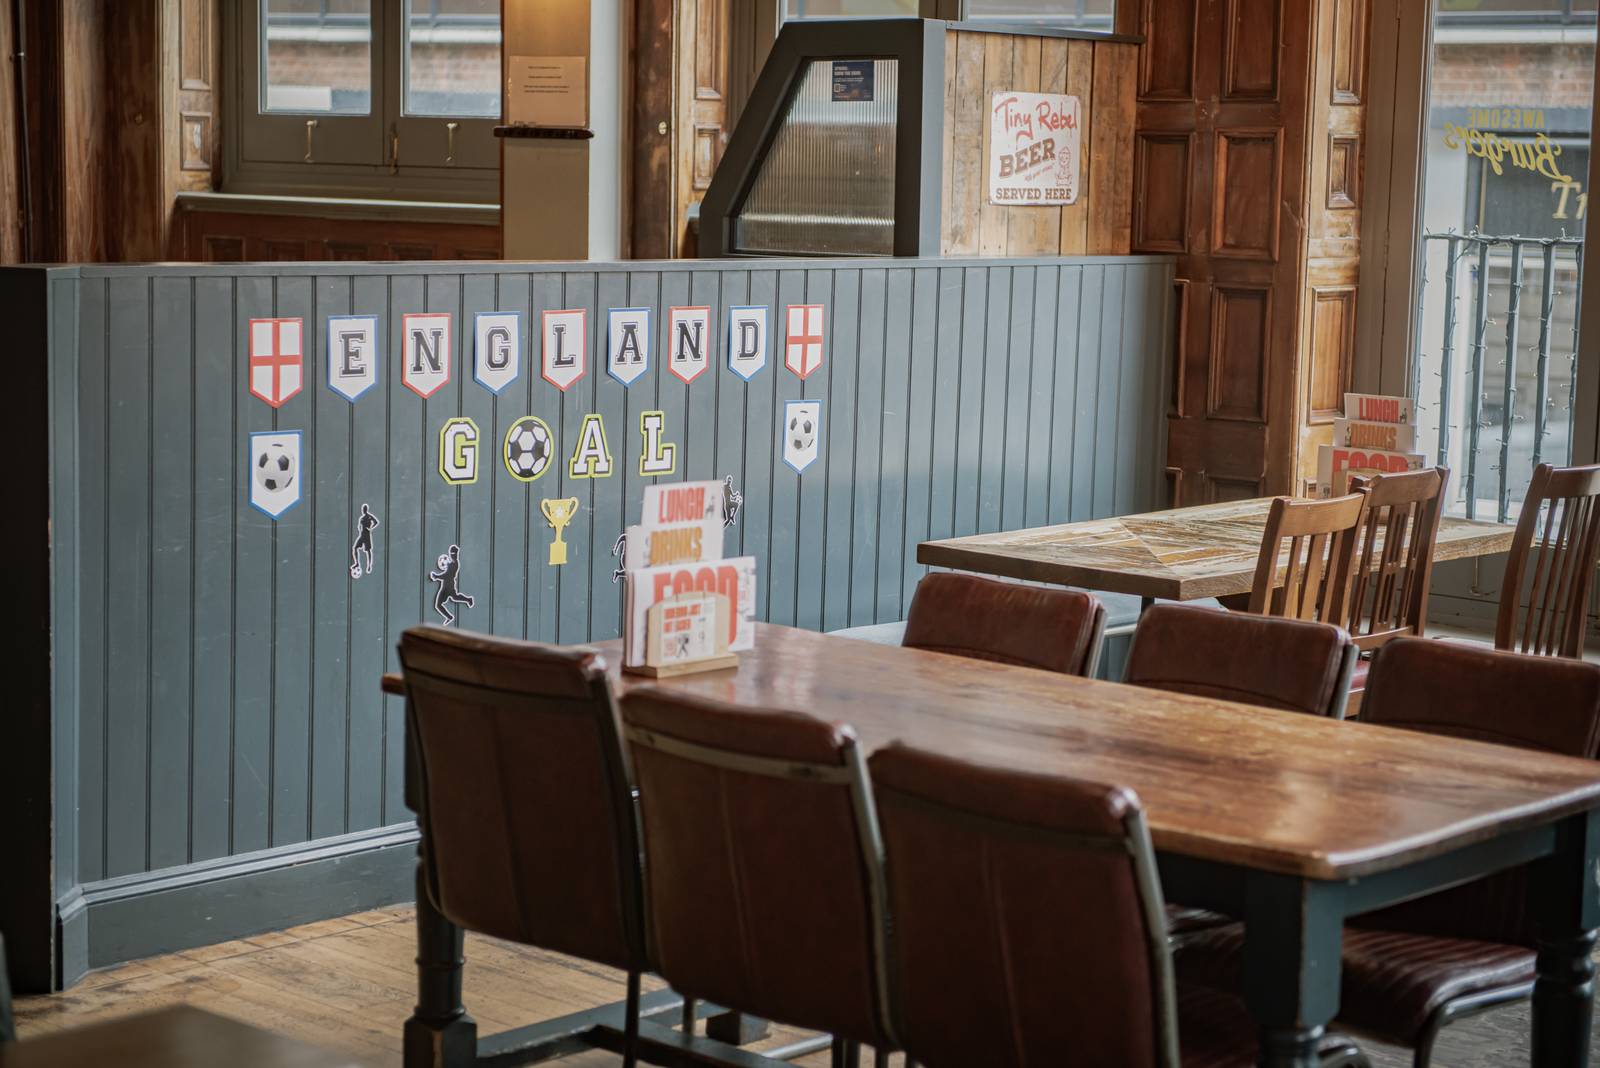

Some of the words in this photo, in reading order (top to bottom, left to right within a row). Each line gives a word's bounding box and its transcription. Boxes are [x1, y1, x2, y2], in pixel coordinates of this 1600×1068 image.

[994, 97, 1033, 140] Tiny
[1036, 100, 1077, 133] Rebel
[999, 138, 1056, 179] BEER
[995, 187, 1042, 200] SERVED
[1045, 187, 1072, 200] HERE
[1359, 397, 1399, 423] LUNCH
[1351, 424, 1397, 451] DRINKS
[658, 487, 705, 524] LUNCH
[649, 527, 702, 566] DRINKS
